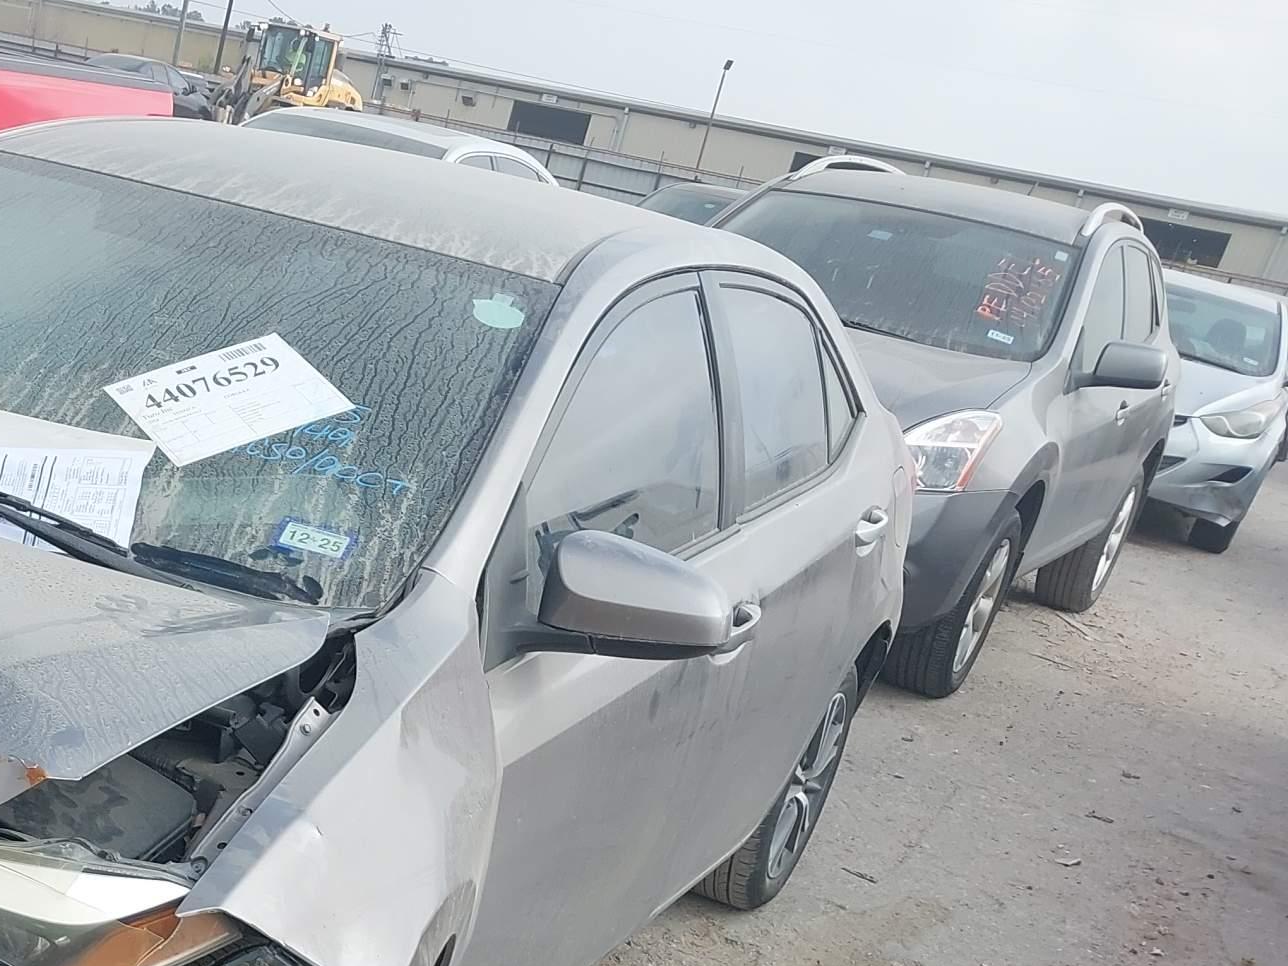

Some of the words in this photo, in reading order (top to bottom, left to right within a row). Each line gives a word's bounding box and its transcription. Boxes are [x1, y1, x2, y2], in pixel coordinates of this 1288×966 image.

[145, 356, 280, 409] 44076529
[289, 529, 310, 544] 12
[318, 537, 343, 552] 25
